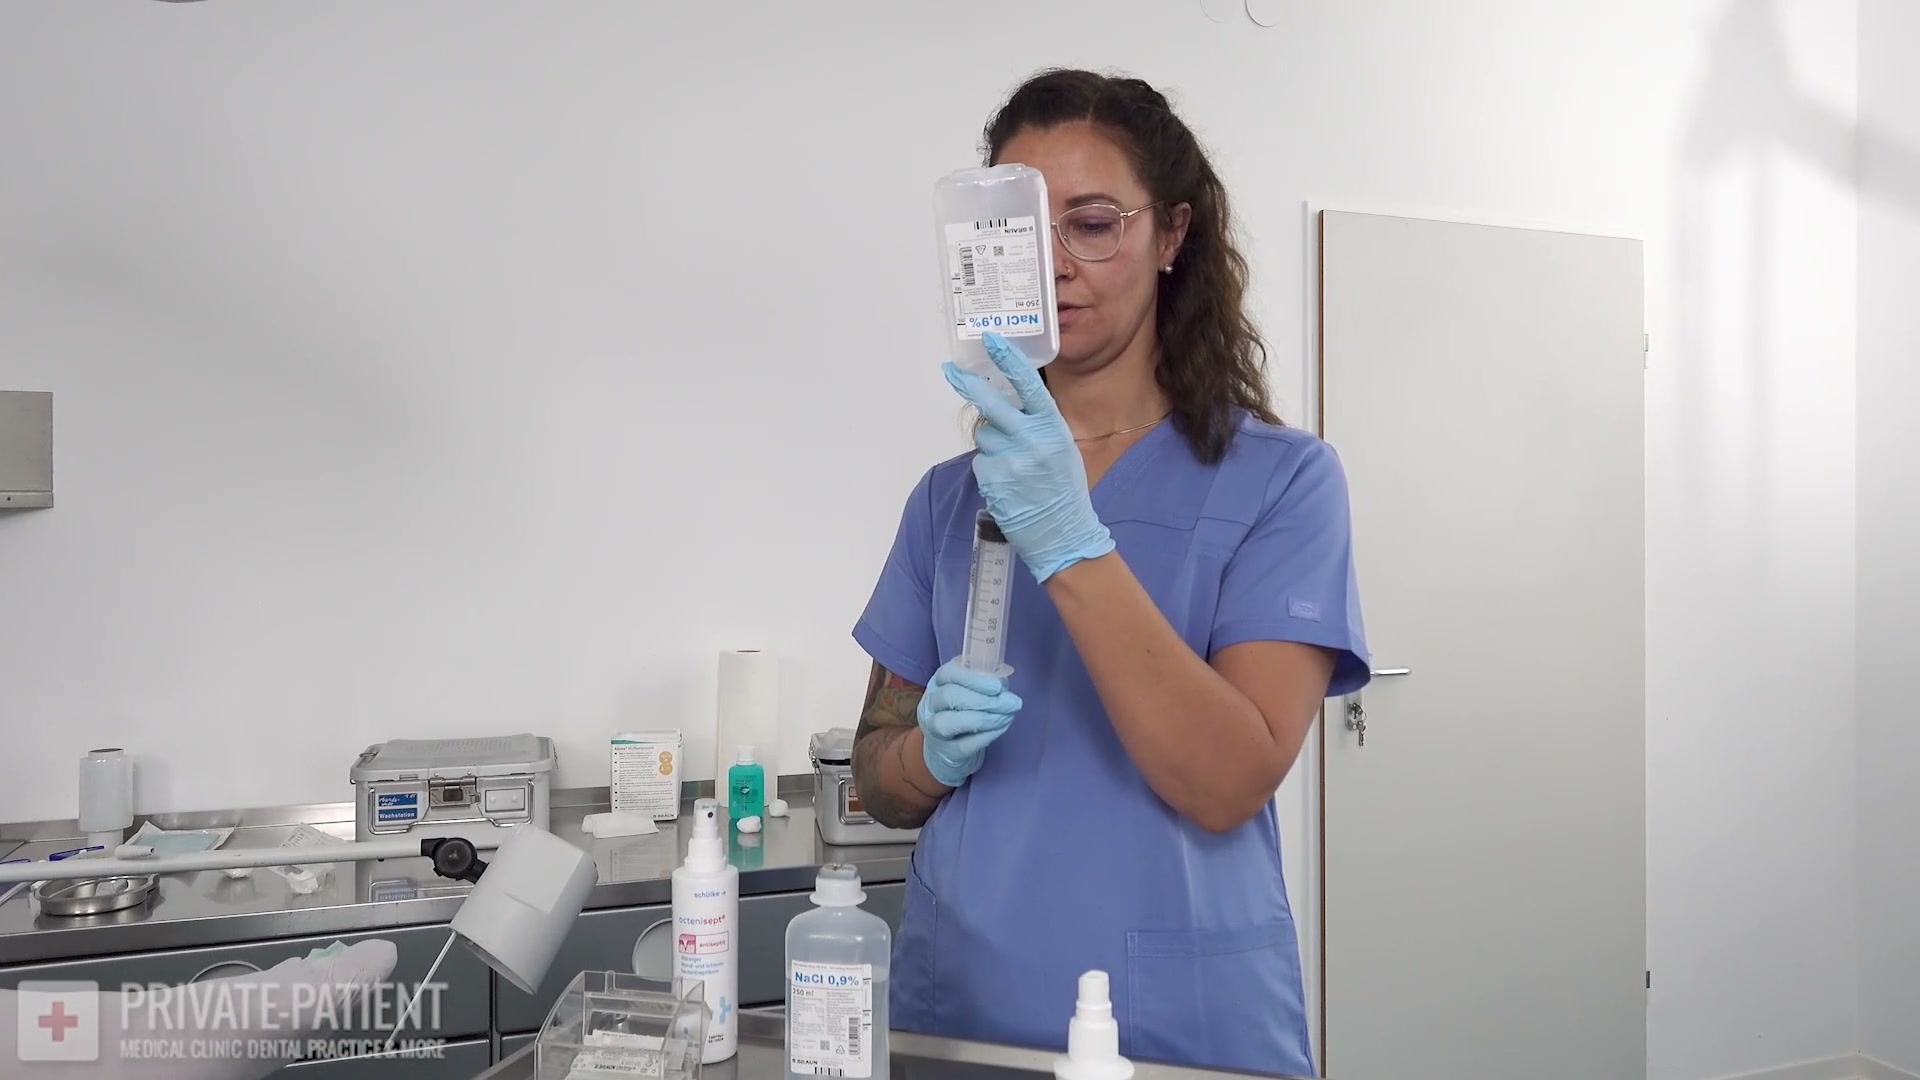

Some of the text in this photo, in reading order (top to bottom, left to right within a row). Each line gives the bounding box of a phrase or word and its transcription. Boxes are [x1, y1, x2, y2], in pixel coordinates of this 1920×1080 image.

[1015, 299, 1040, 308] 250 ml
[969, 314, 1039, 328] NaCl 0,9%
[699, 940, 726, 948] antiseptic
[795, 971, 859, 987] NaCl 0,9%
[792, 987, 805, 996] 250
